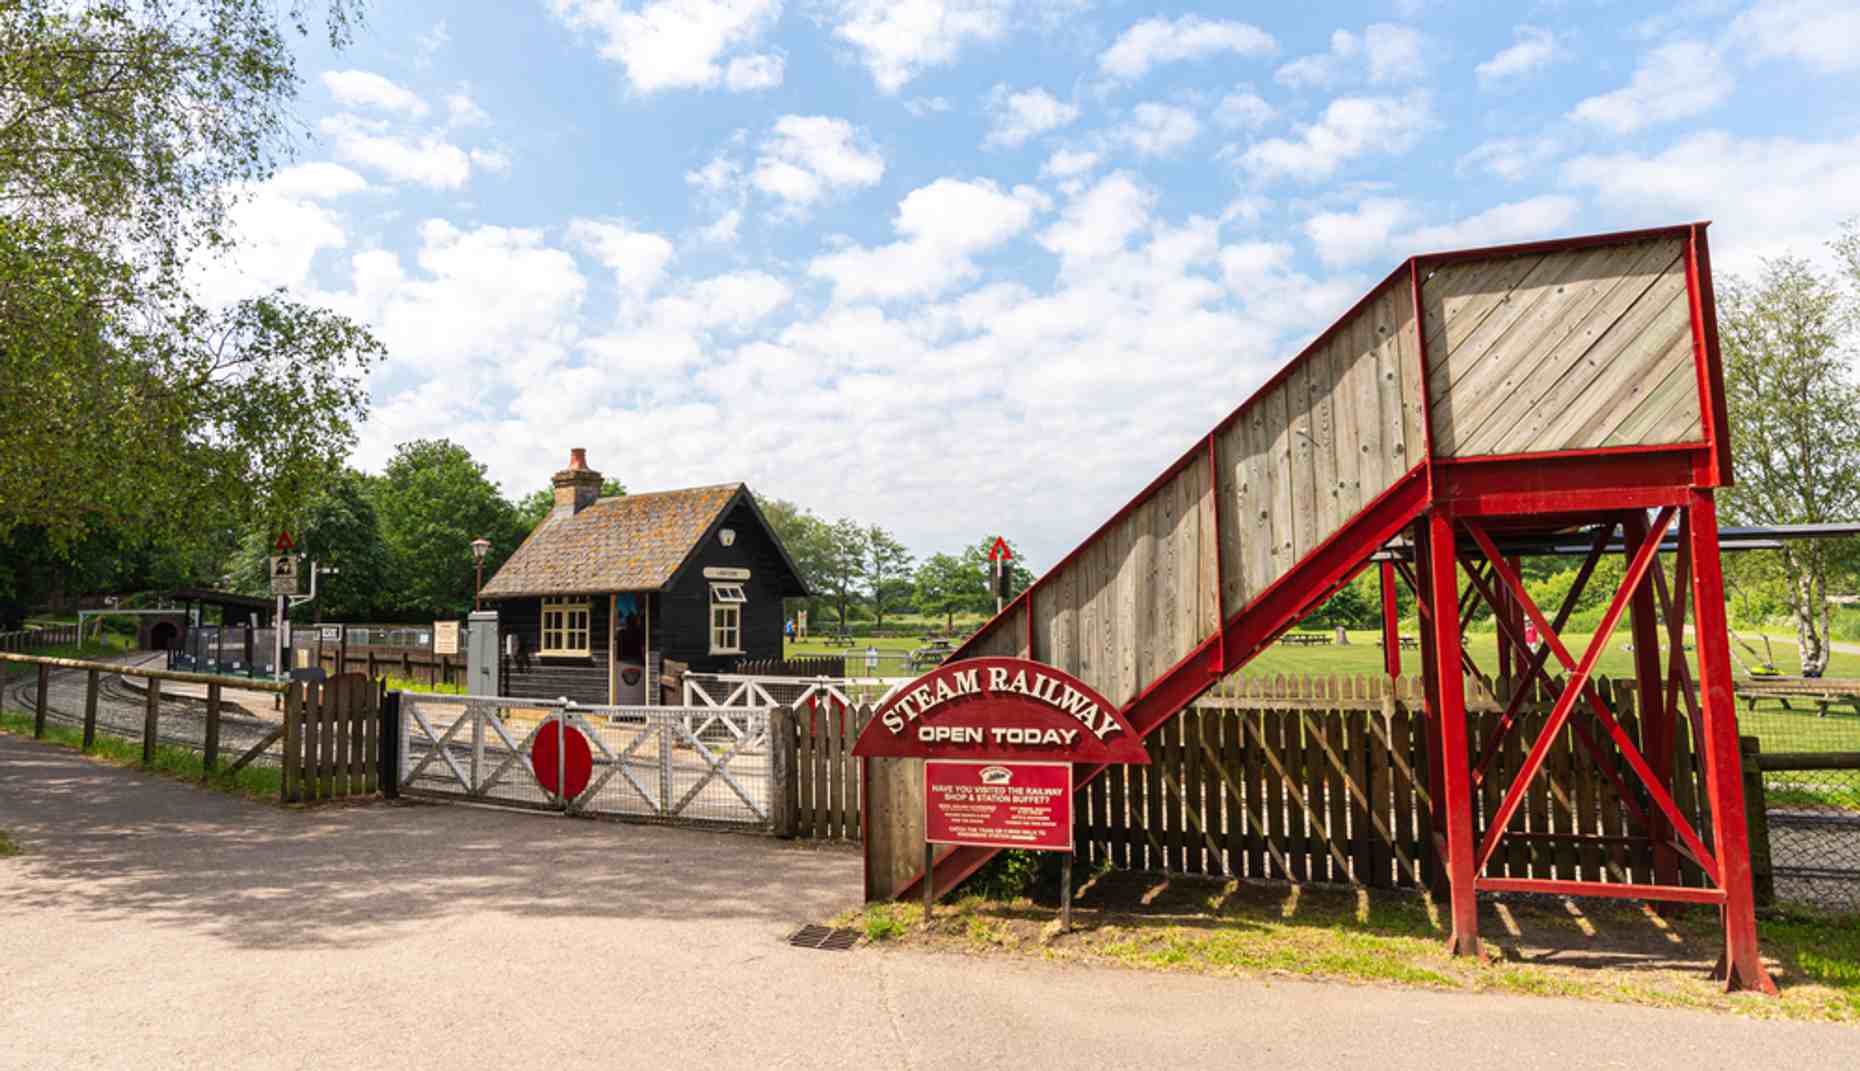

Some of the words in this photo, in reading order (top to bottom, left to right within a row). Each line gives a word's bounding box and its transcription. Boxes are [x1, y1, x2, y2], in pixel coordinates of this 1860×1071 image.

[882, 668, 981, 735] STEAM
[987, 667, 1122, 741] RAILWAY
[918, 726, 983, 742] OPEN
[991, 728, 1078, 744] TODAY
[931, 785, 953, 793] HAVE
[955, 785, 973, 793] YOU
[975, 785, 1006, 795] VISITED
[1008, 786, 1024, 795] THE
[1026, 787, 1063, 797] RAILWAY
[944, 793, 968, 801] SHOP
[977, 794, 1011, 803] STATION
[1012, 795, 1051, 804] BUFFET?
